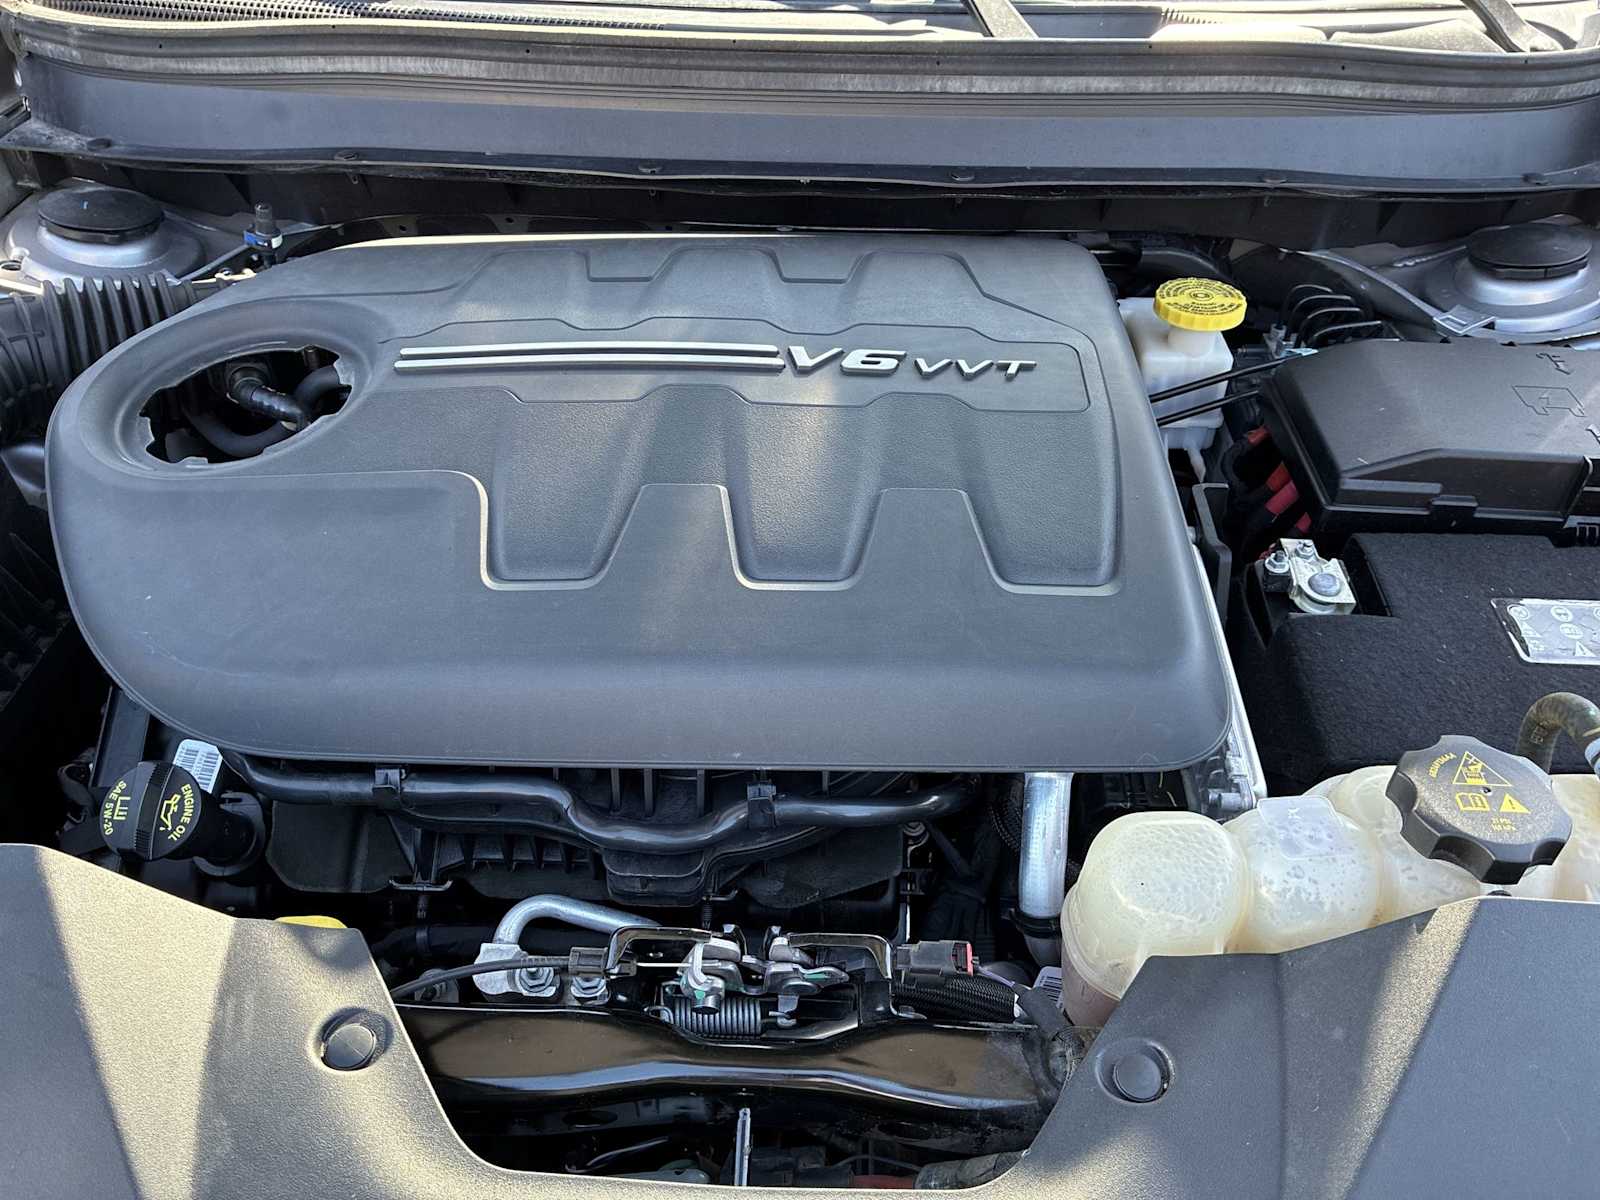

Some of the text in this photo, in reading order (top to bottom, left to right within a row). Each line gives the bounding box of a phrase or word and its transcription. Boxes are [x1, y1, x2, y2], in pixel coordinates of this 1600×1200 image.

[787, 345, 1038, 382] V6 VVT
[103, 780, 126, 835] SAE 5W-20
[167, 783, 194, 841] ENGINE OIL
